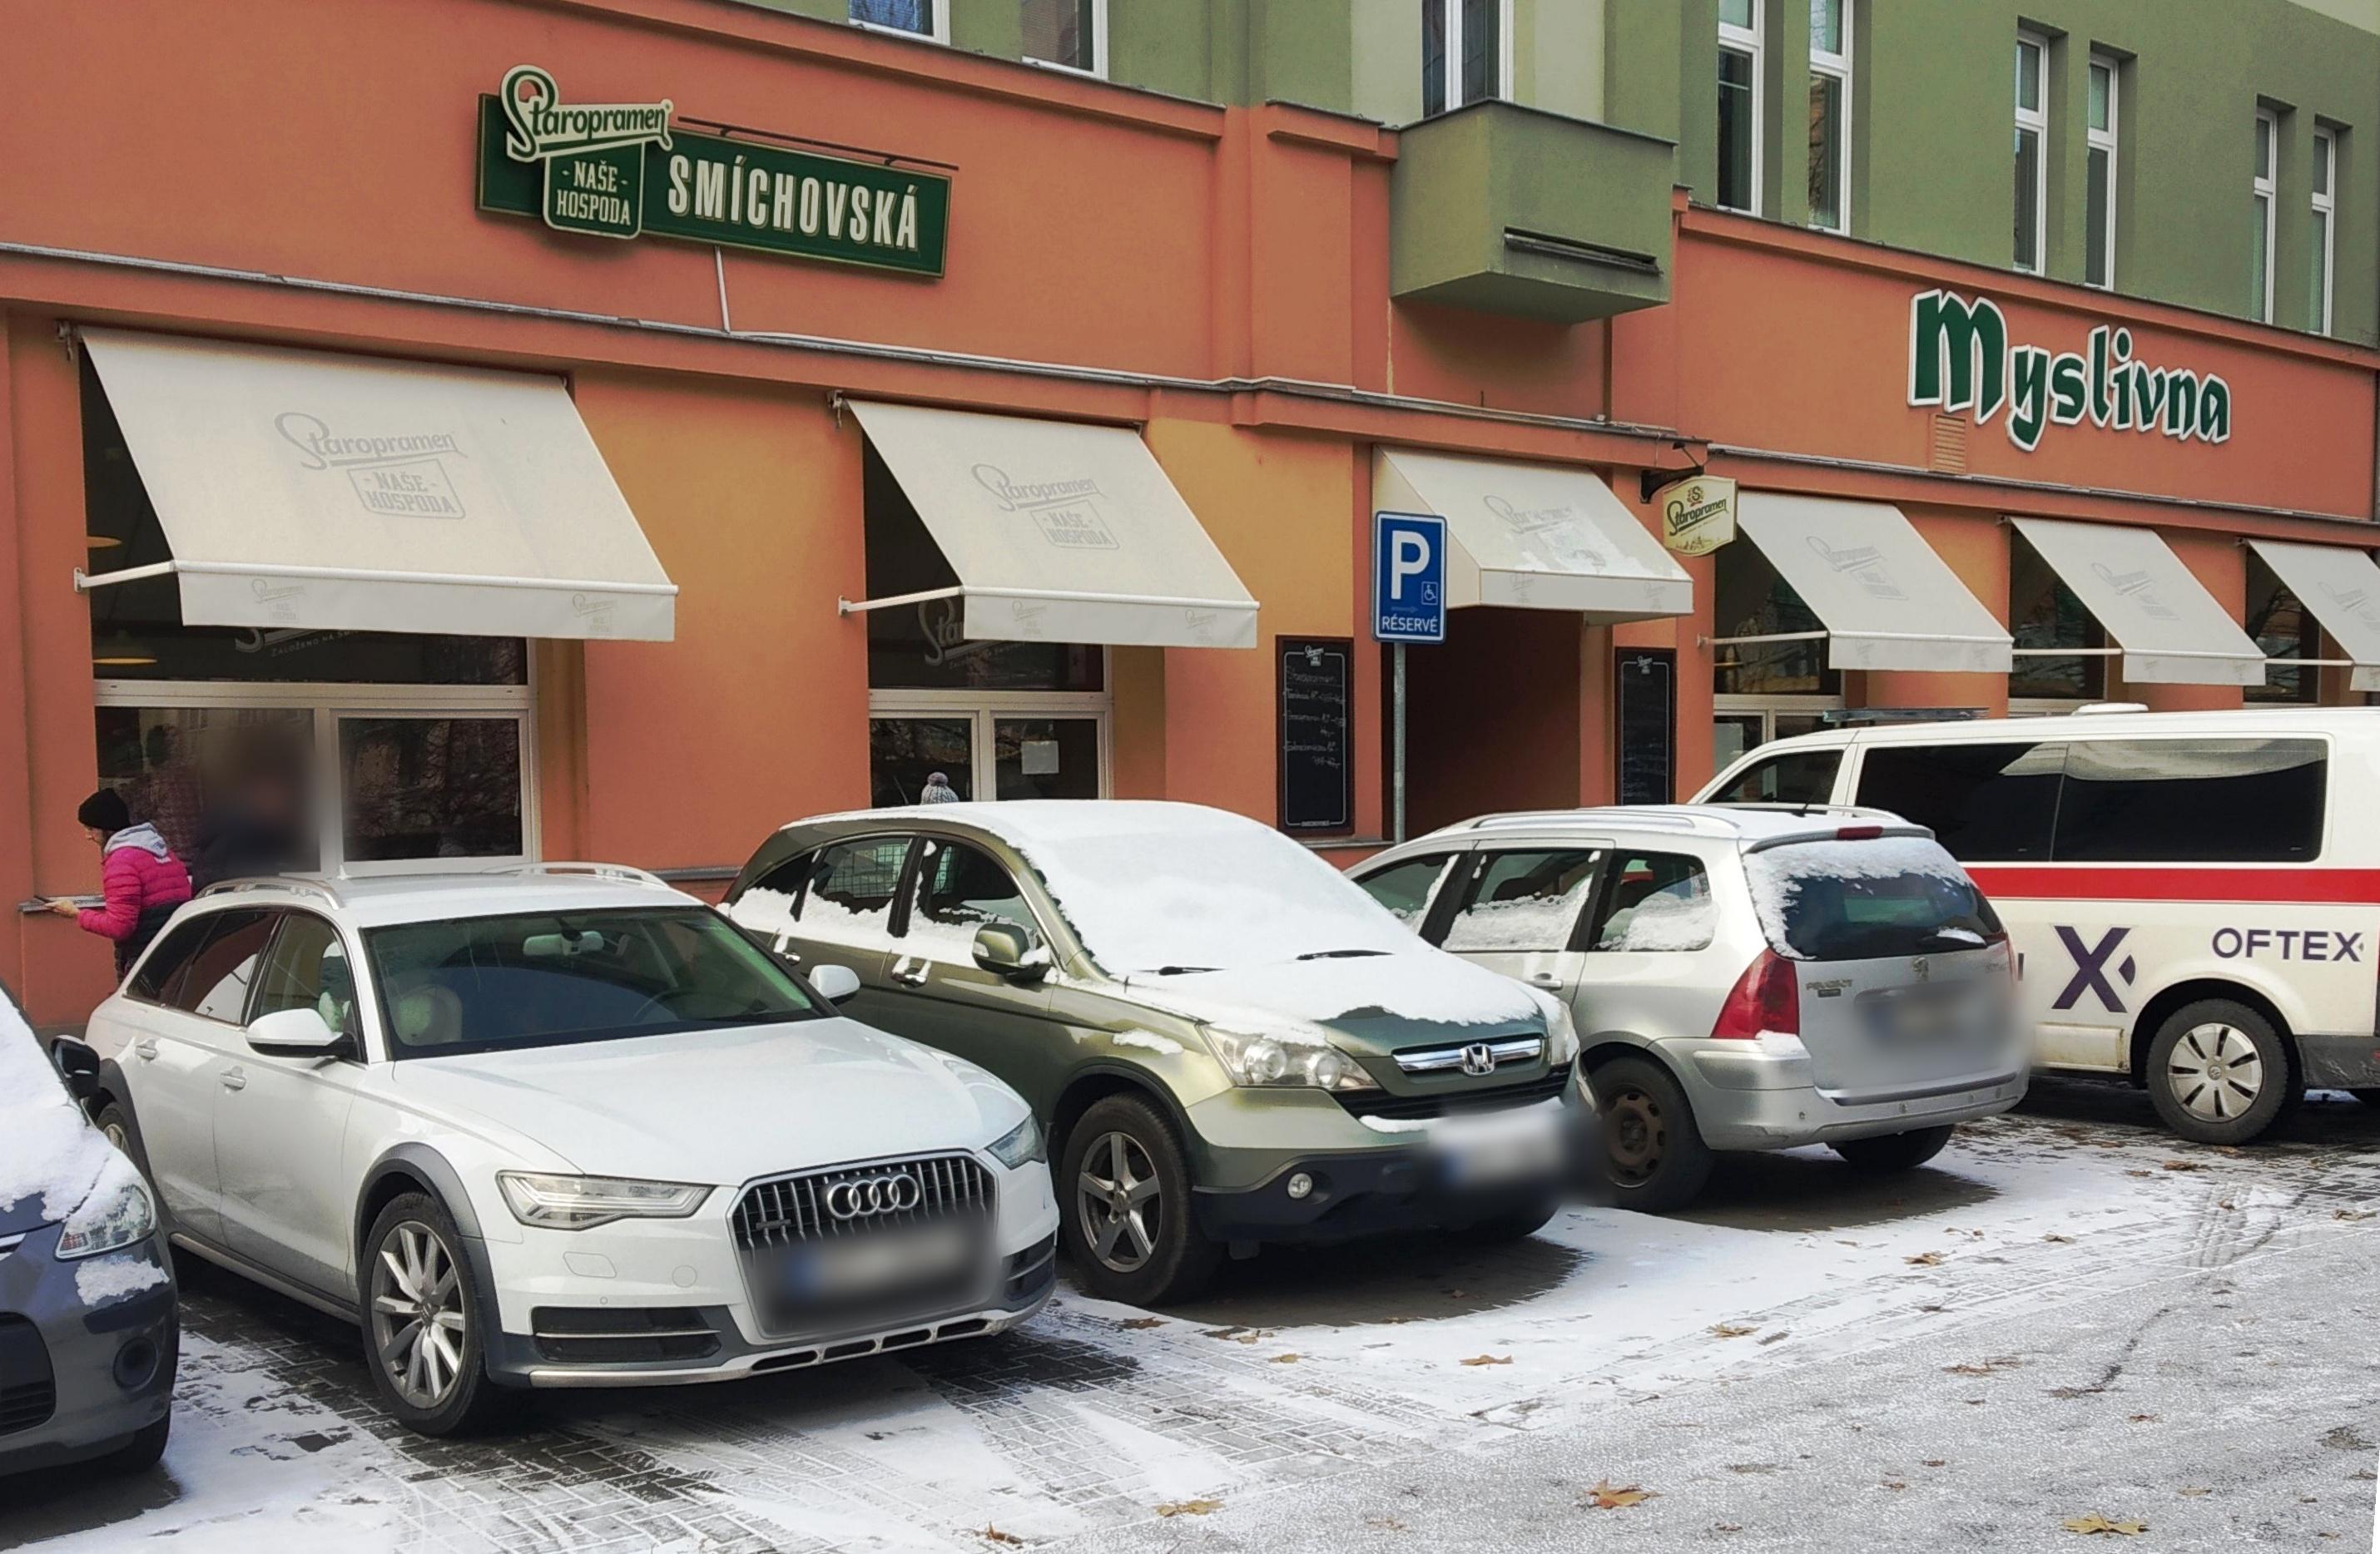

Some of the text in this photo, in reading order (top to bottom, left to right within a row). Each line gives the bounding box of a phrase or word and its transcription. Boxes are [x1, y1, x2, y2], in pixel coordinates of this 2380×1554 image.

[504, 70, 670, 158] Staropramen
[573, 160, 617, 192] NAŠE
[556, 189, 631, 225] HOSPODA
[667, 154, 919, 250] SMÍCHOVSKÁ
[1908, 289, 2231, 451] Myslivna
[274, 412, 468, 470] Staropramen
[373, 471, 429, 492] NAŠE
[971, 463, 1107, 512] Staropramen
[364, 490, 458, 514] HOSPODA
[1667, 498, 1728, 537] Staropramen
[1391, 530, 1430, 600] P
[1381, 613, 1439, 633] RÉSERVÉ
[2212, 928, 2363, 963] OFTEX
